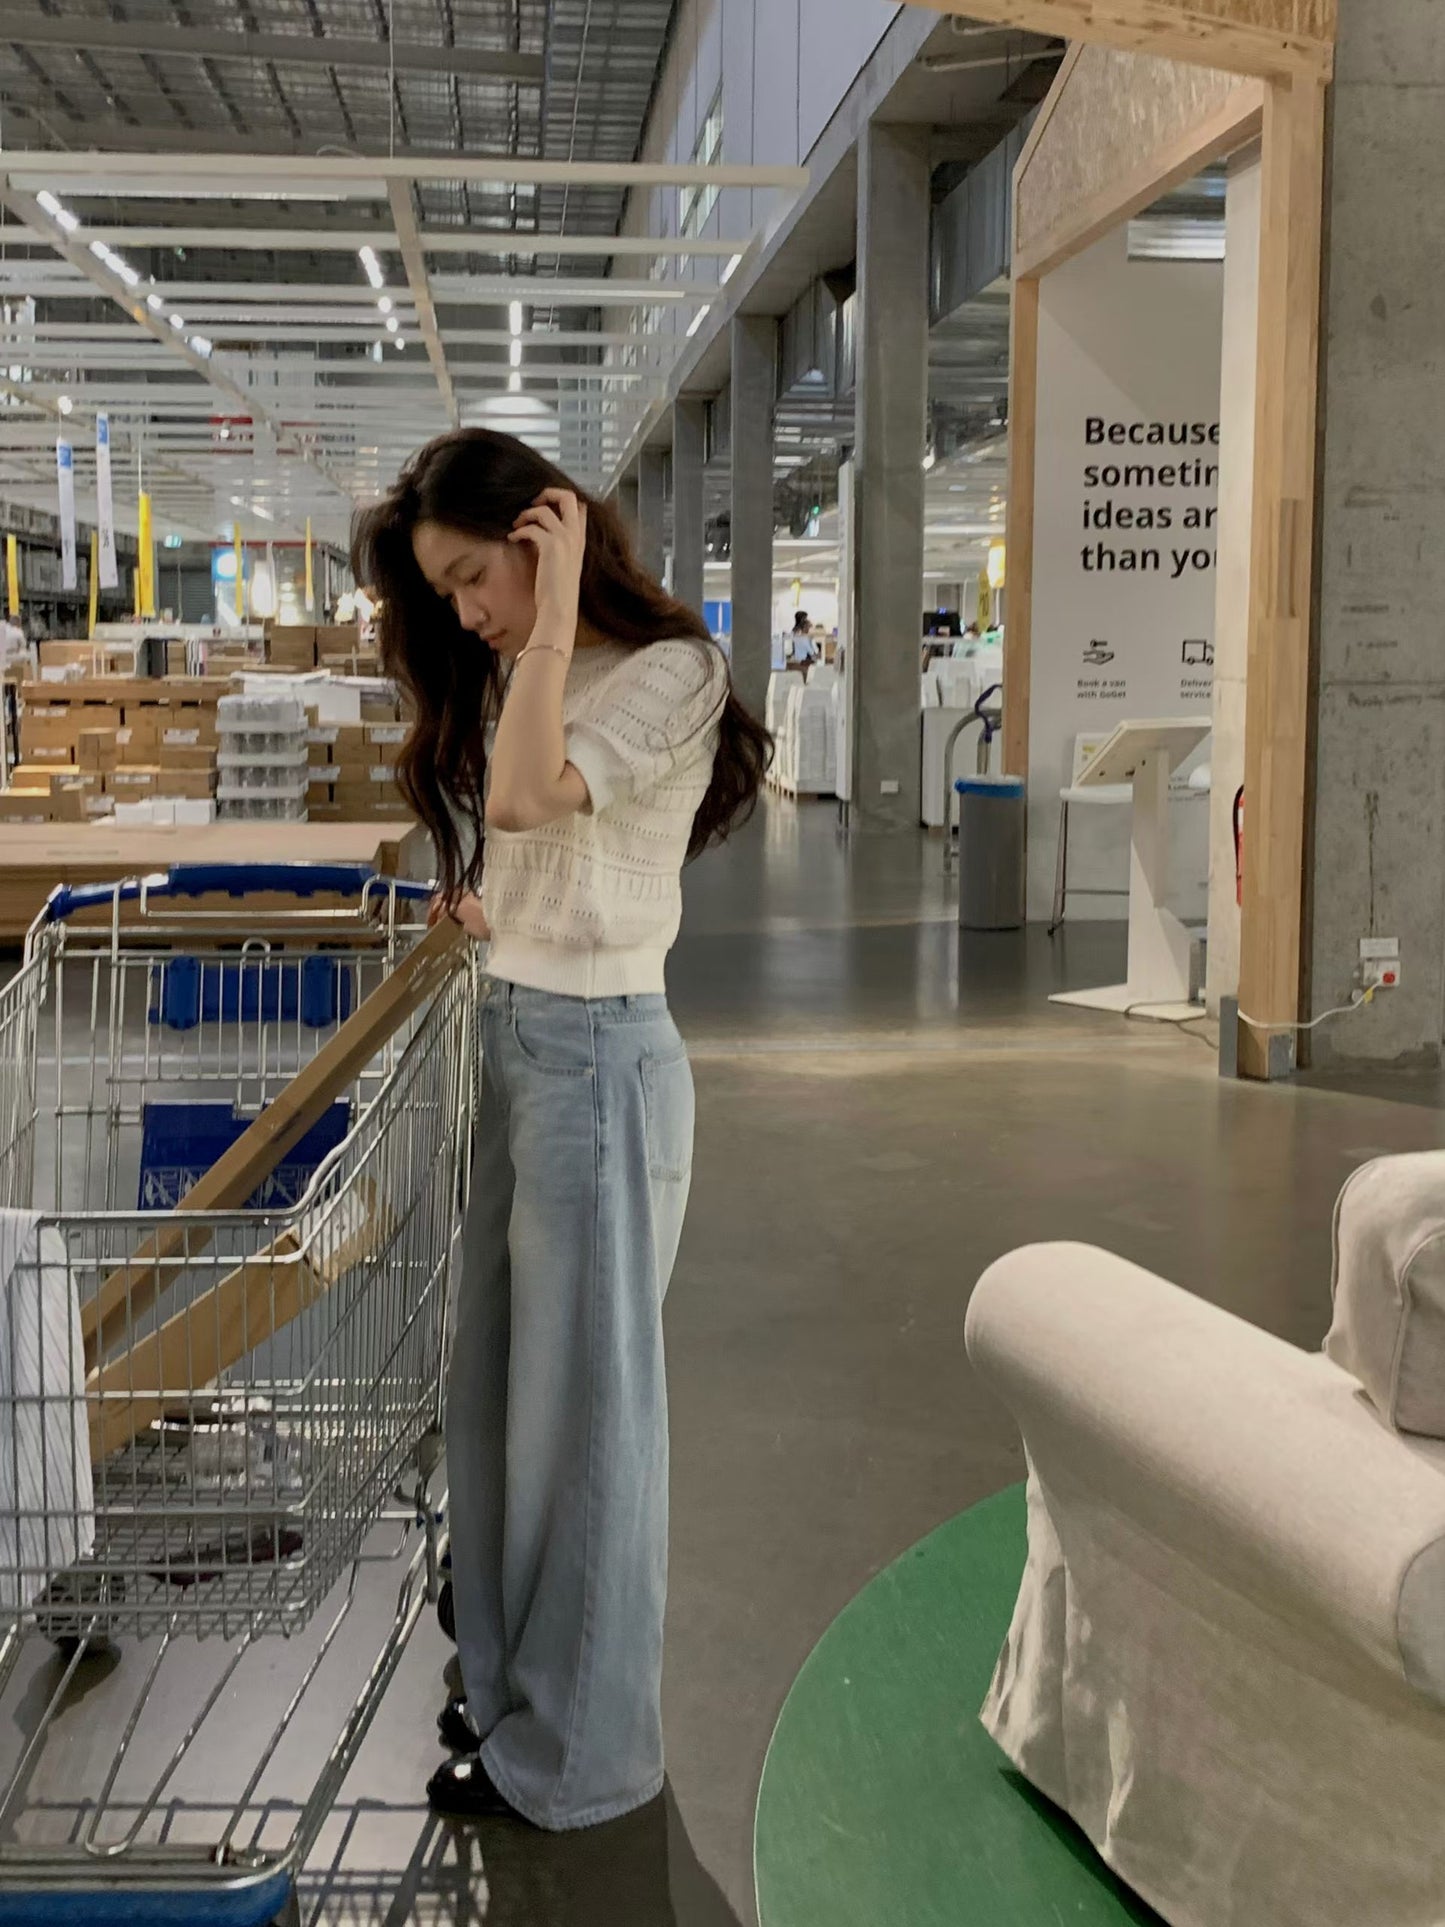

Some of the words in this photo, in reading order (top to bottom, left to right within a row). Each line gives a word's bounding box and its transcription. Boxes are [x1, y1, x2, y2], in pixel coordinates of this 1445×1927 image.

[1085, 417, 1220, 445] Because
[1083, 499, 1172, 529] ideas
[1081, 541, 1160, 570] than
[1171, 549, 1217, 578] yo
[1077, 679, 1099, 687] Book
